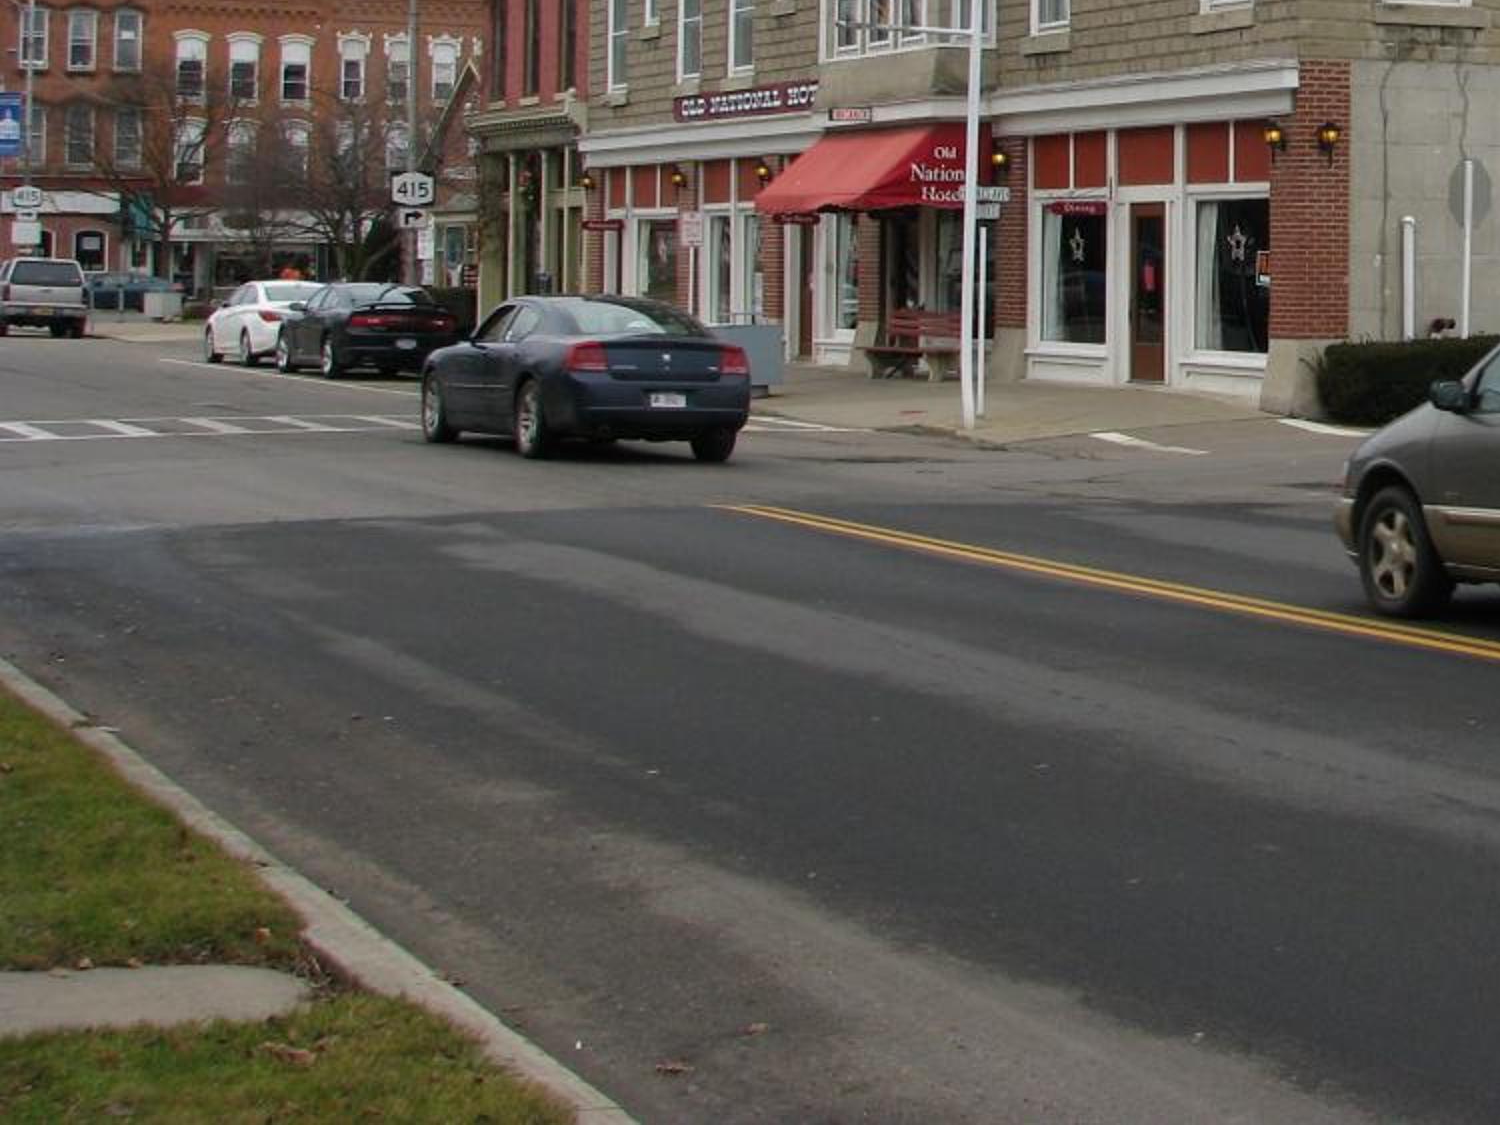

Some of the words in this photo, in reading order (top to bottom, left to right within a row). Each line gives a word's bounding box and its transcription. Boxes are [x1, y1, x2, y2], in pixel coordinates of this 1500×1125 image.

[681, 93, 706, 116] OLD
[709, 85, 781, 113] NATIONAL
[787, 79, 819, 106] HOT
[933, 146, 957, 160] Old
[910, 162, 967, 182] Nation
[396, 181, 430, 198] 415
